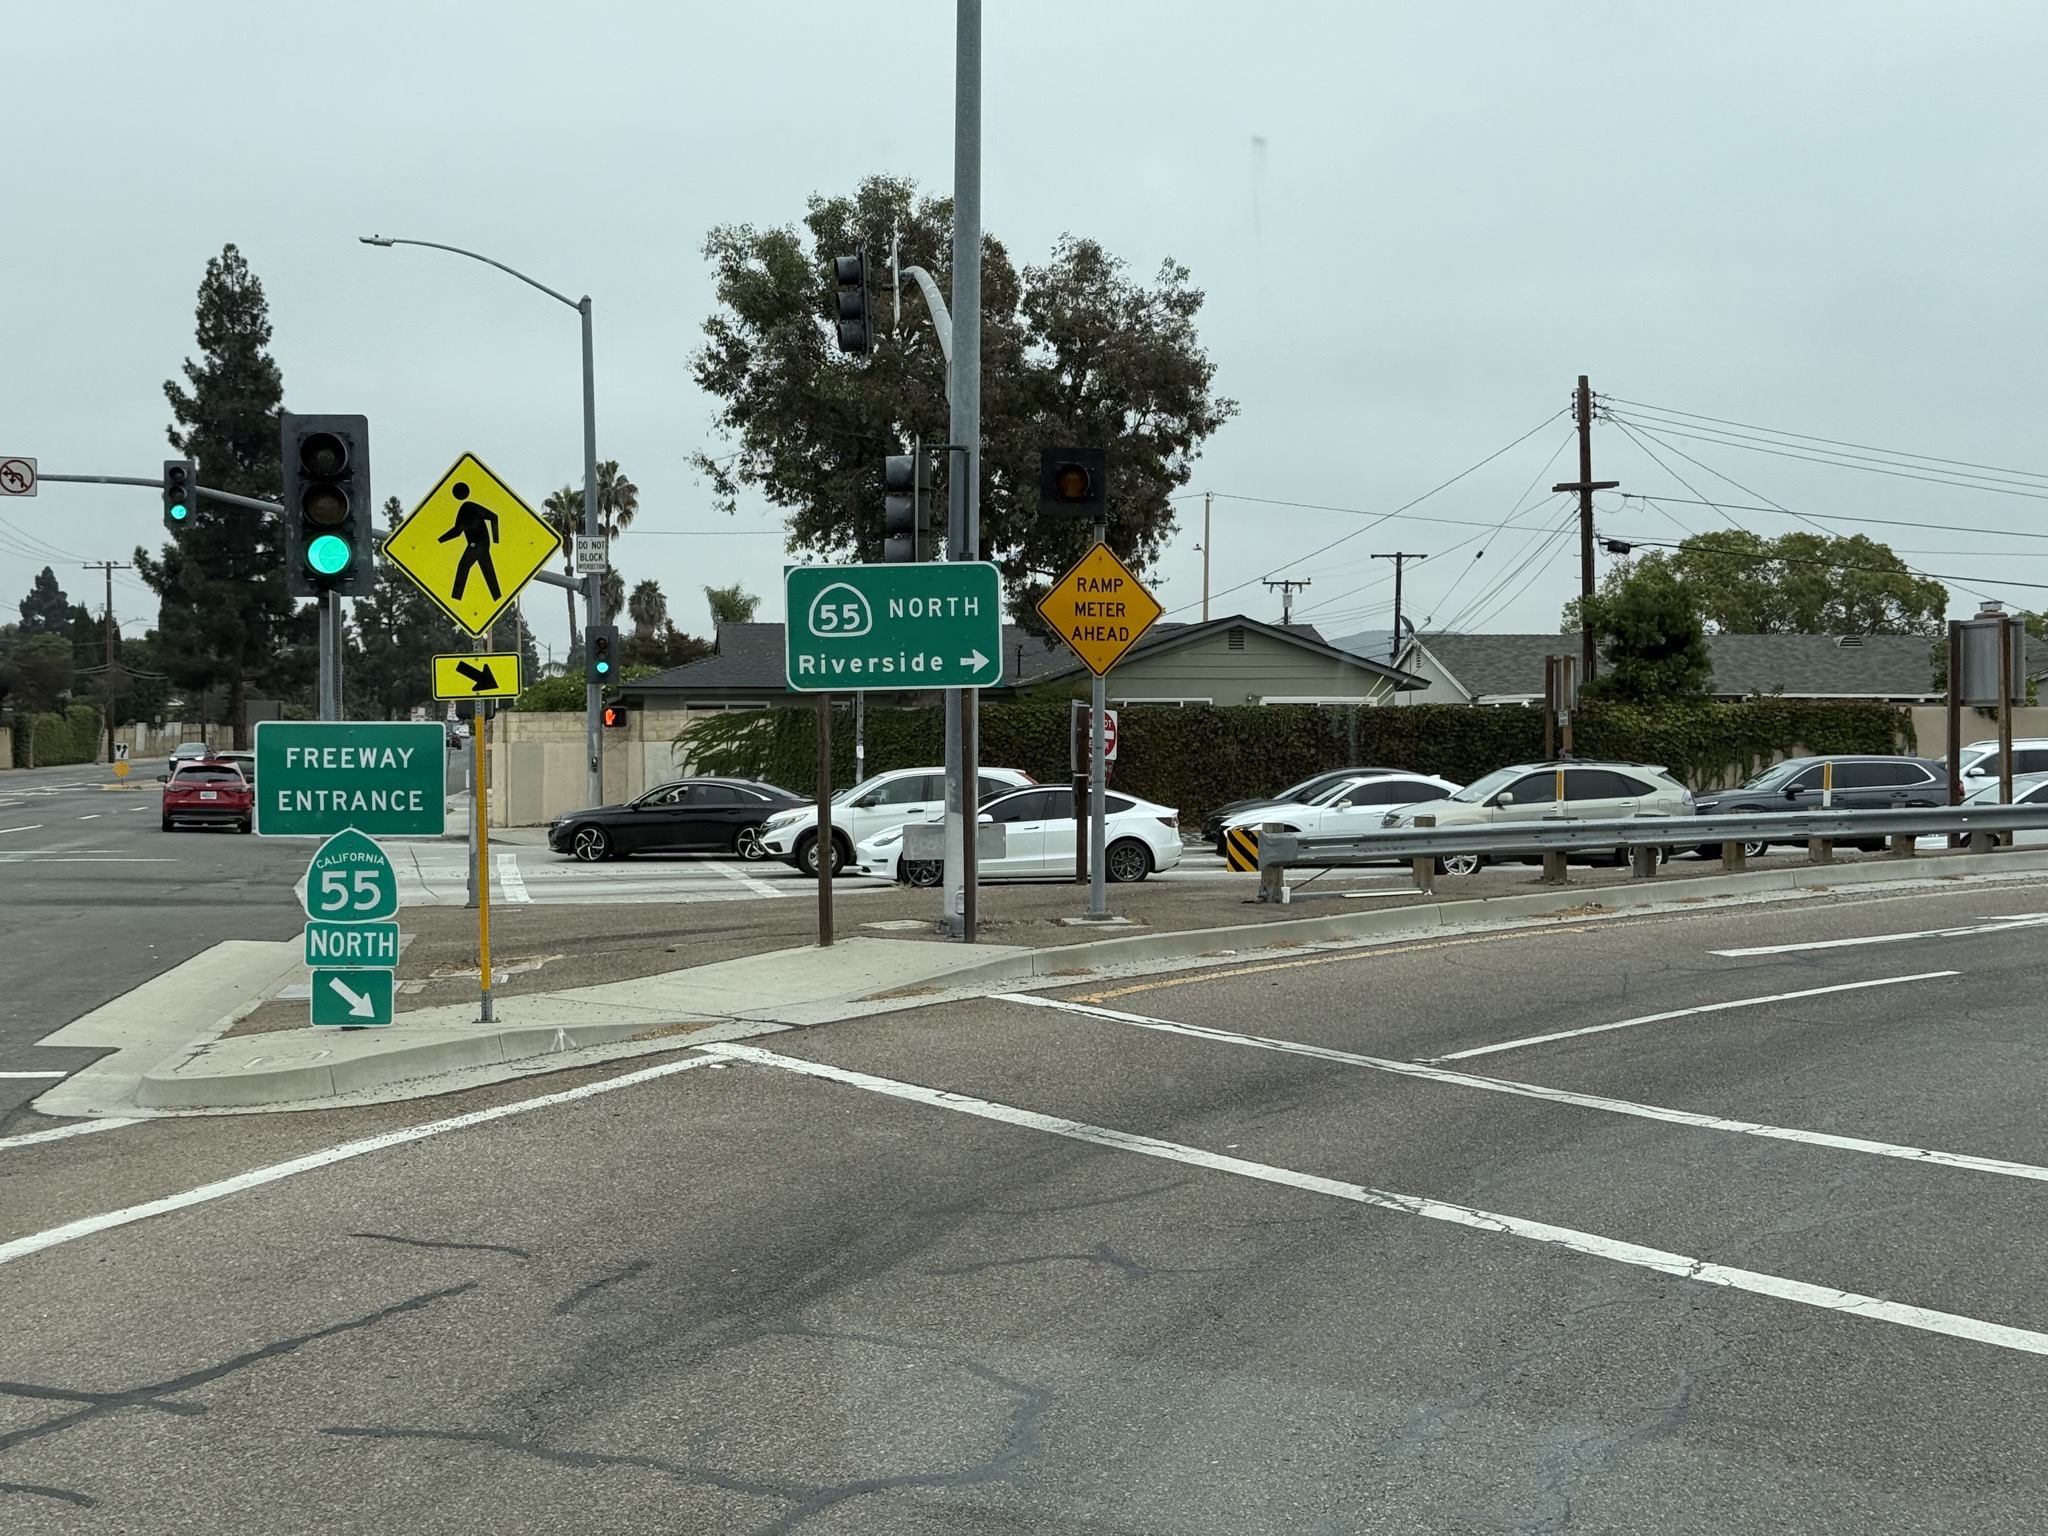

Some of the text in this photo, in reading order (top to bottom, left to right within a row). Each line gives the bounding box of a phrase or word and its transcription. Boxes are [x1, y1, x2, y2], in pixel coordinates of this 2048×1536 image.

[578, 540, 605, 550] DO NOT
[579, 552, 604, 562] BLOCK
[1076, 577, 1124, 593] RAMP
[820, 596, 979, 631] 55 NORTH
[1074, 601, 1126, 618] METER
[1071, 625, 1130, 642] AHEAD
[798, 651, 944, 675] Riverside
[286, 747, 415, 769] FREEWAY
[277, 789, 424, 811] ENTRANCE
[315, 852, 385, 870] CALIFORNIA
[320, 870, 382, 911] 55
[310, 929, 394, 957] NORTH
